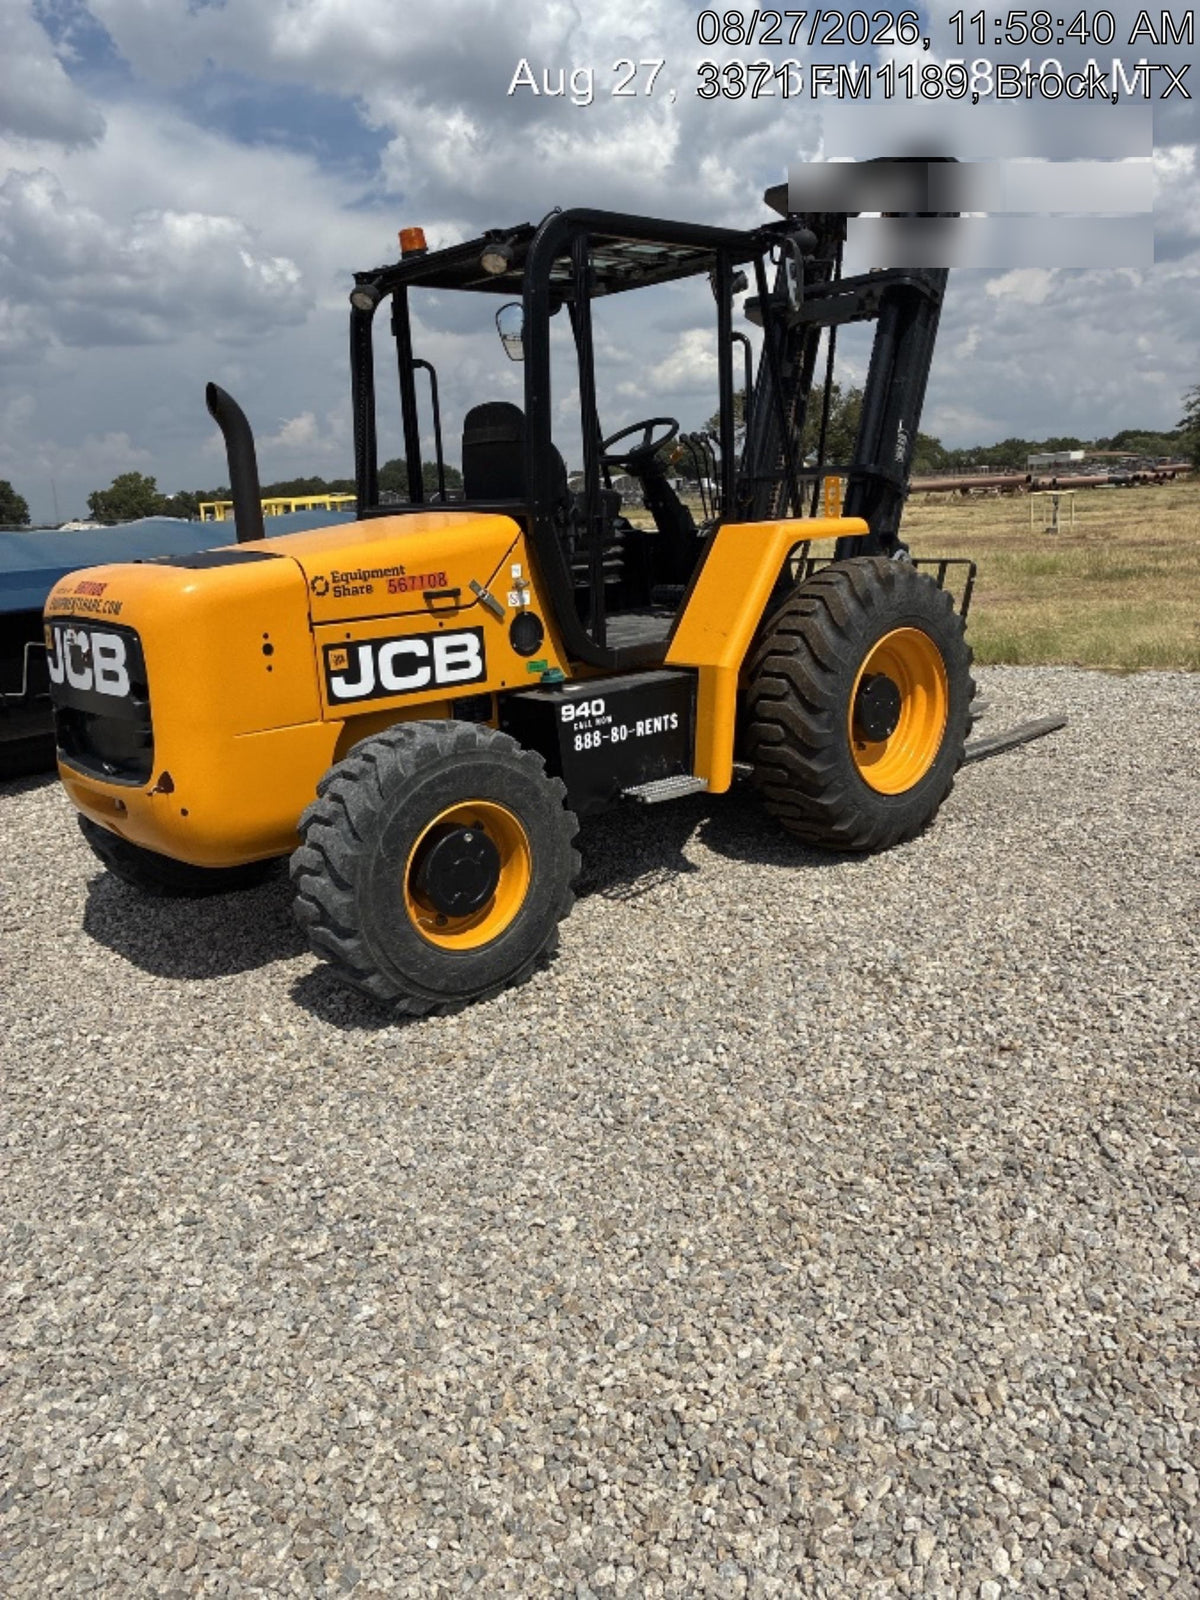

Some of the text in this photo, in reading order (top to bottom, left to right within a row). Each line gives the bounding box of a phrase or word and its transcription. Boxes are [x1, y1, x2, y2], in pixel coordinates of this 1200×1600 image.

[330, 564, 405, 585] Equipment
[387, 571, 448, 595] 567108
[332, 583, 375, 598] Share
[47, 626, 131, 698] JCB
[330, 631, 484, 699] JCB
[561, 698, 605, 723] 940
[573, 719, 593, 732] CALL
[574, 712, 679, 751] 888-80-RENTS
